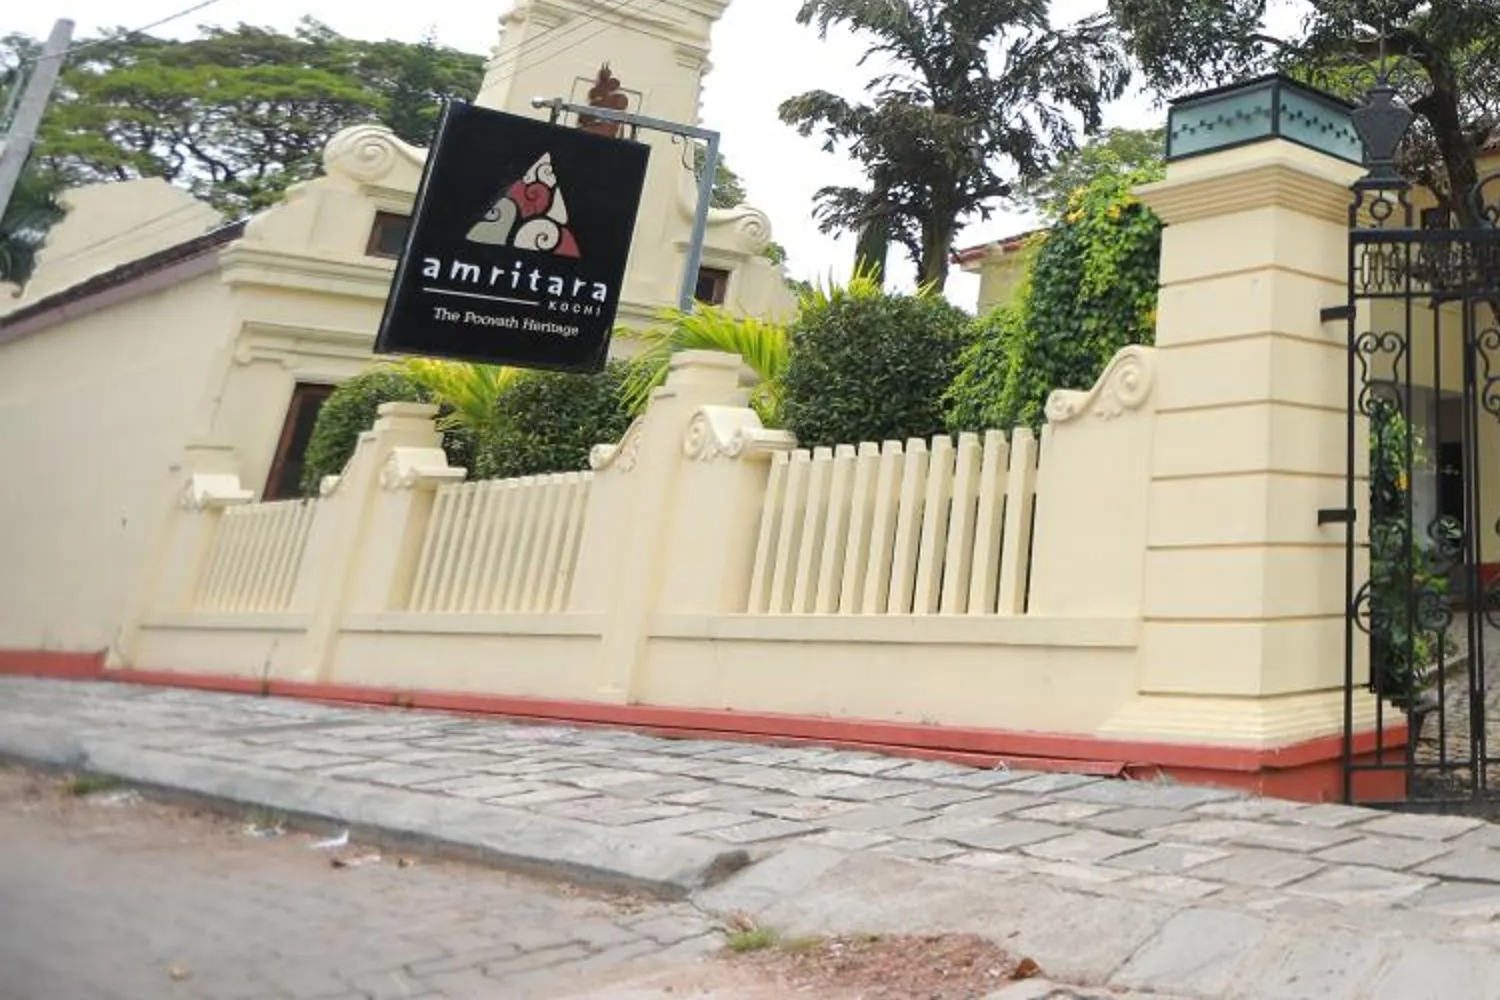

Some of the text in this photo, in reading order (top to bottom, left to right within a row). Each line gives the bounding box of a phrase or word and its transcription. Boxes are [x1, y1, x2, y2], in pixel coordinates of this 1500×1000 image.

[422, 257, 607, 303] amritara
[432, 306, 580, 337] The Poovath Heritage
[548, 301, 601, 317] KOCHI
